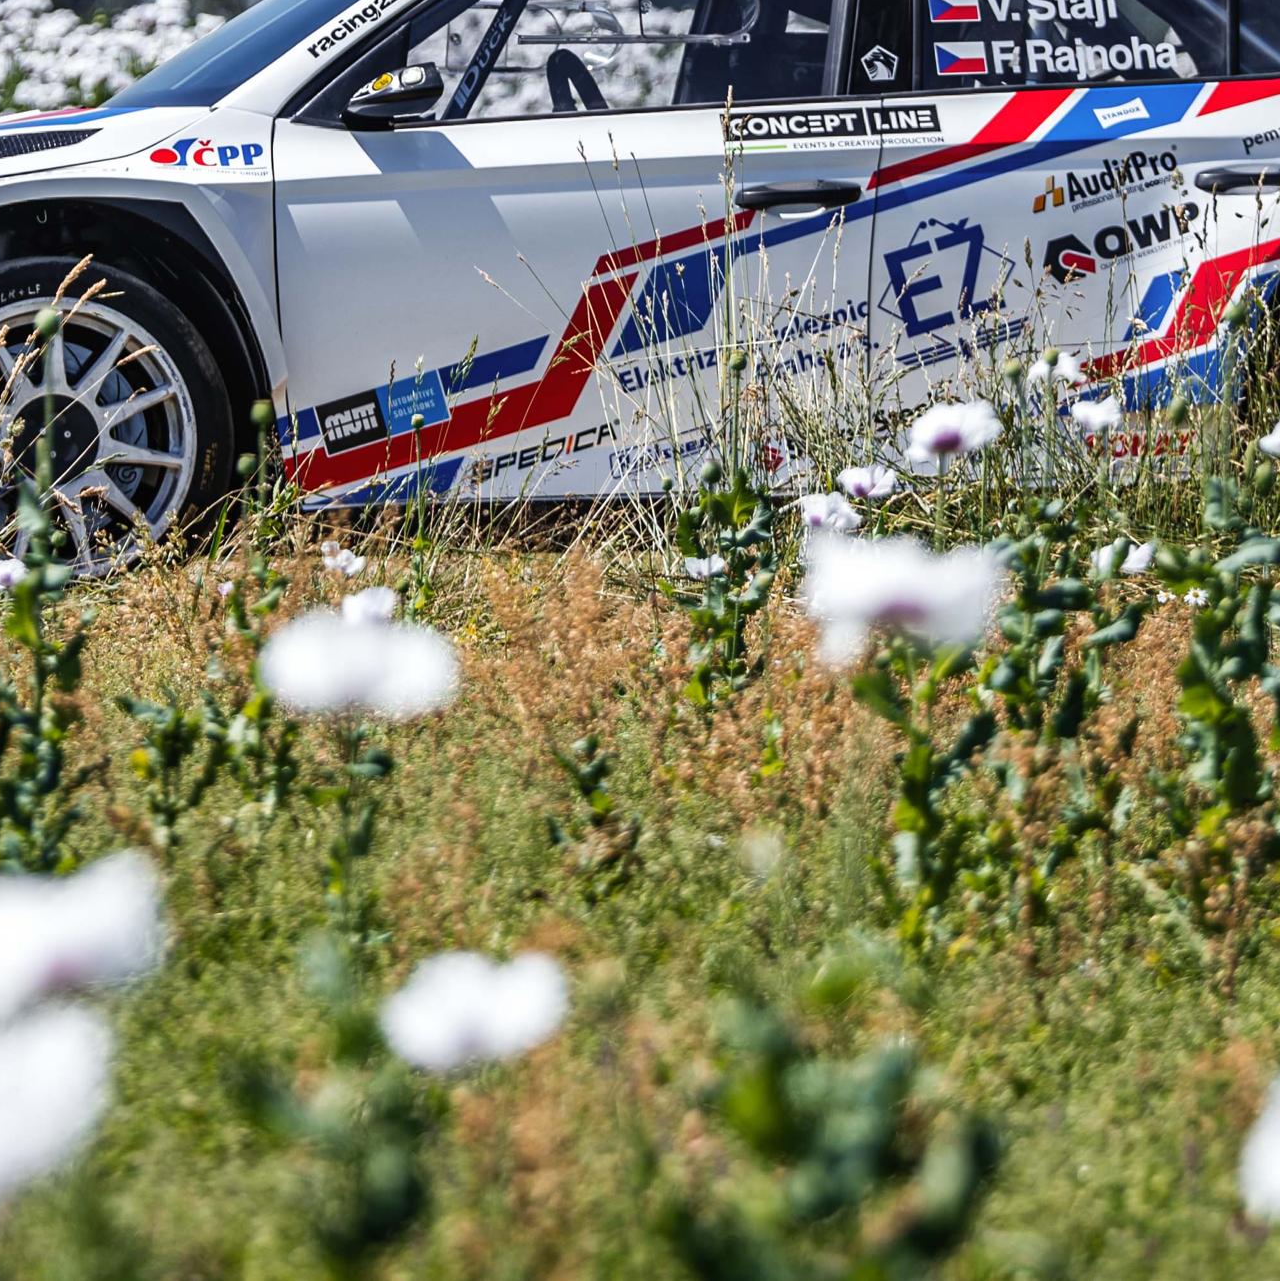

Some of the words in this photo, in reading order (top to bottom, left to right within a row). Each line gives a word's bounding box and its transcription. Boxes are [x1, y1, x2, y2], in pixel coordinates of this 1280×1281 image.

[1025, 36, 1178, 81] Rajnoha
[731, 113, 857, 137] CONCEPT
[875, 109, 934, 130] LINE
[193, 139, 264, 167] ČPP
[882, 136, 945, 145] PRODUCTION
